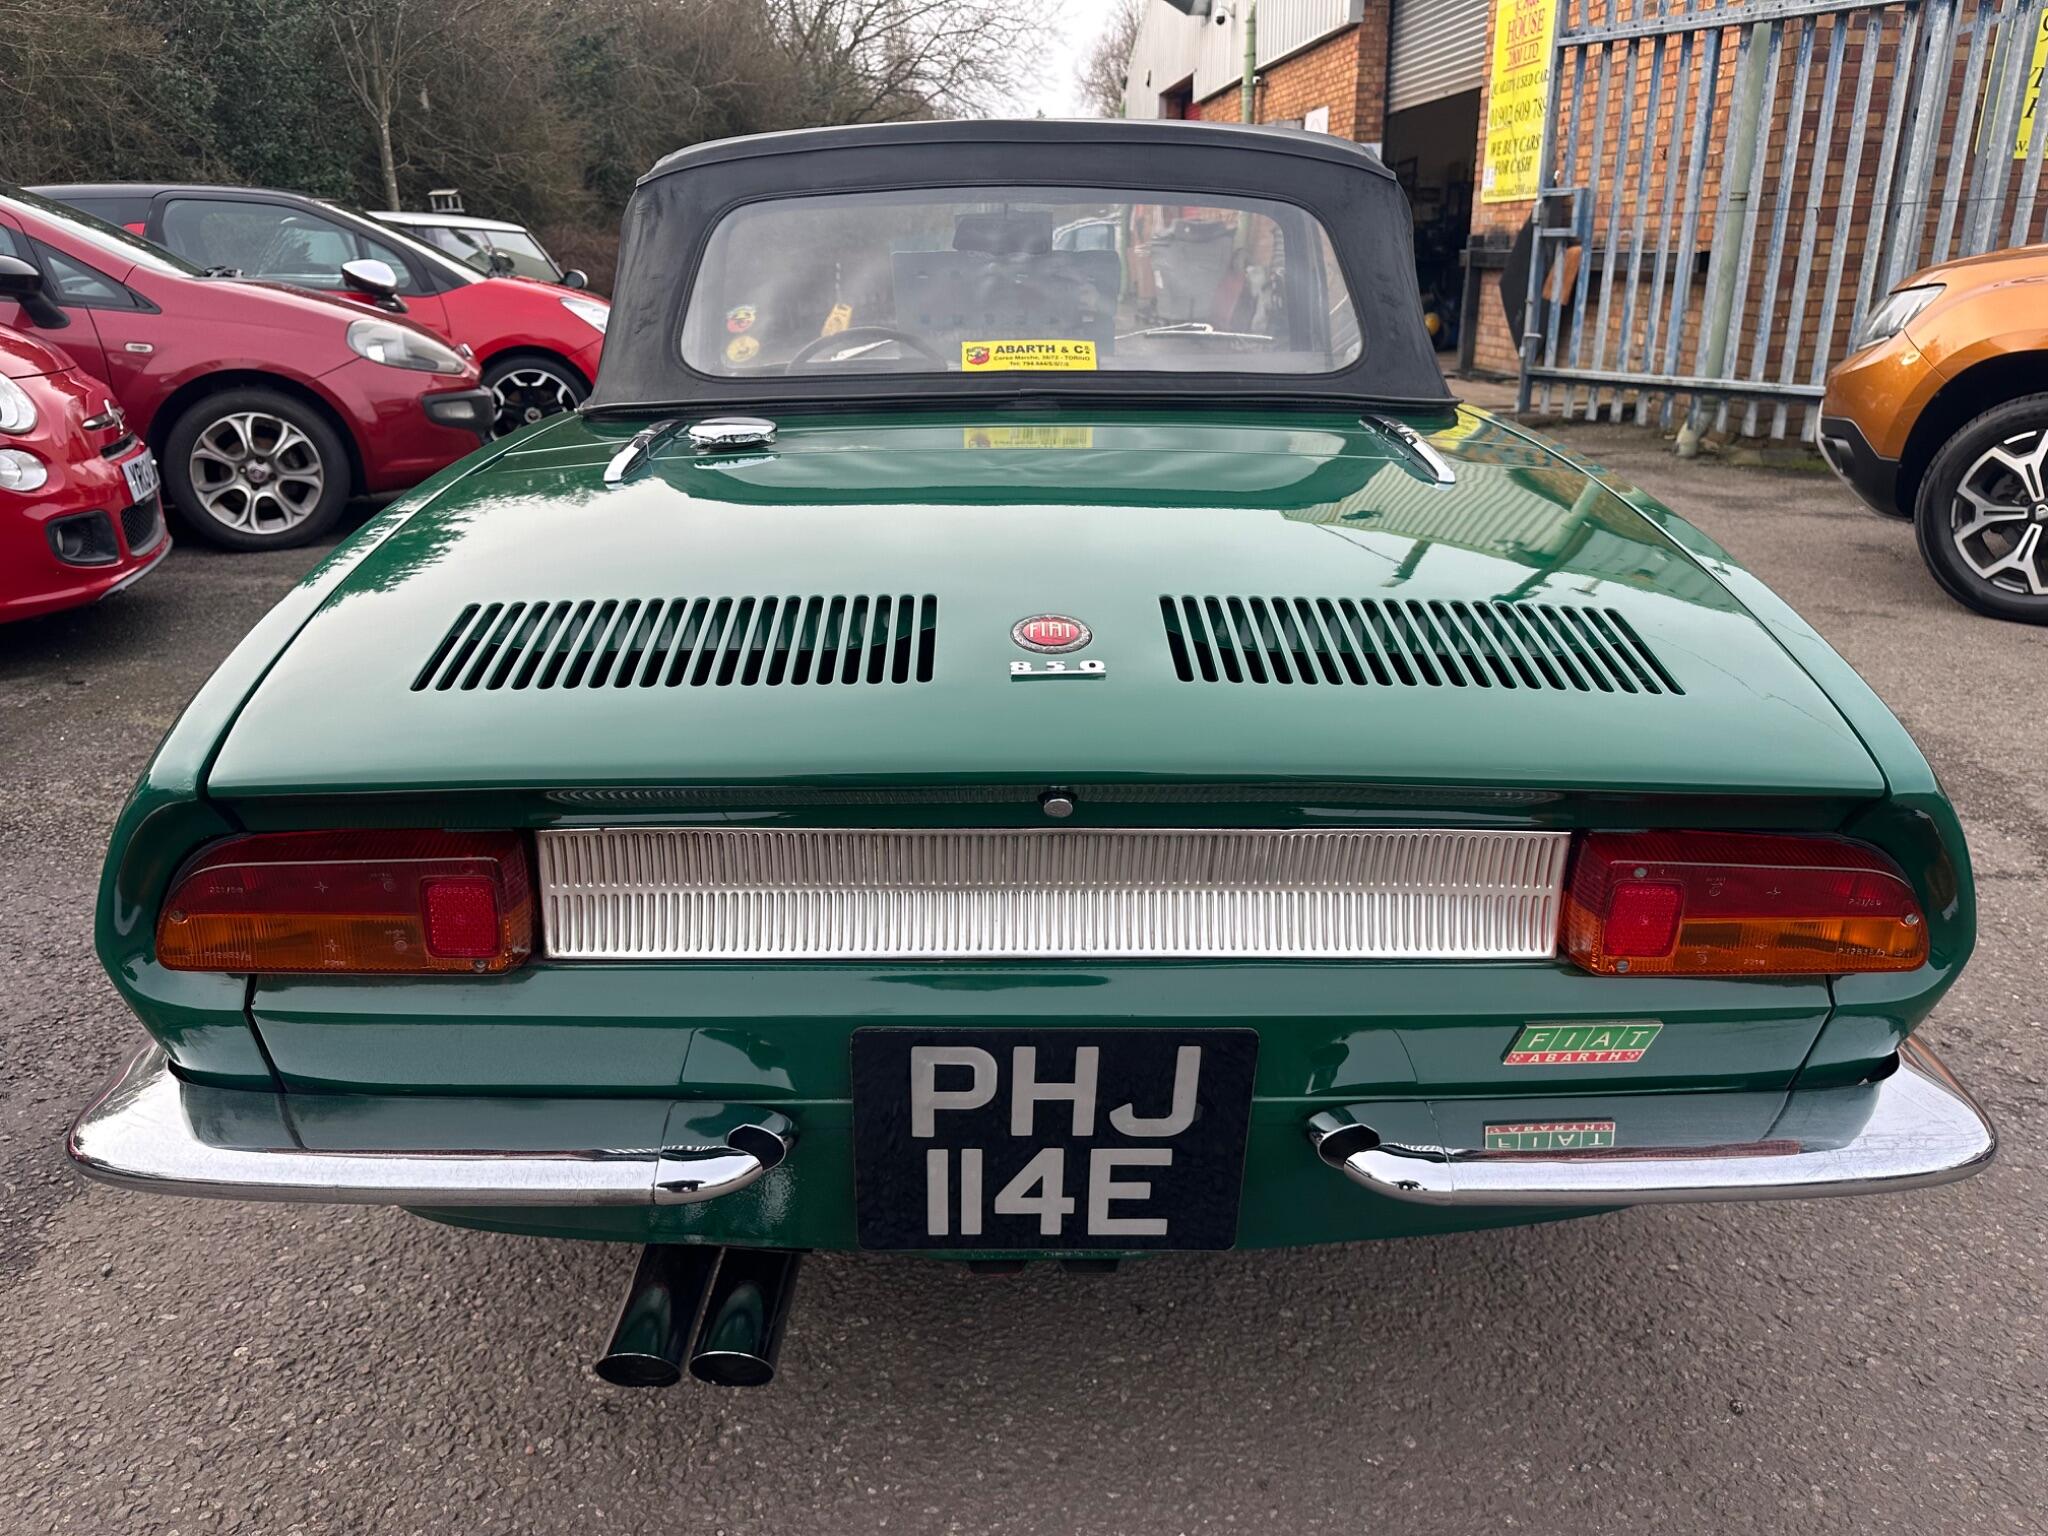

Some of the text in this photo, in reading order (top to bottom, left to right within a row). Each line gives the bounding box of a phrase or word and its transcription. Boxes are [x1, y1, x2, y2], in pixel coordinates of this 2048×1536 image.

[1507, 8, 1545, 43] HOUSE
[1524, 42, 1539, 61] LTD
[1534, 69, 1550, 85] CAR
[1514, 100, 1531, 122] 609
[1490, 134, 1542, 156] WE BUY CARS
[1495, 156, 1532, 176] FOR CASH
[995, 344, 1056, 354] ABARTH
[1061, 346, 1069, 354] &
[1029, 621, 1073, 638] FIAT
[1009, 660, 1105, 672] 850
[1527, 1031, 1649, 1049] FIAT
[1528, 1052, 1623, 1063] ABARTH
[911, 1045, 1202, 1138] PHJ
[926, 1147, 1174, 1236] 114E
